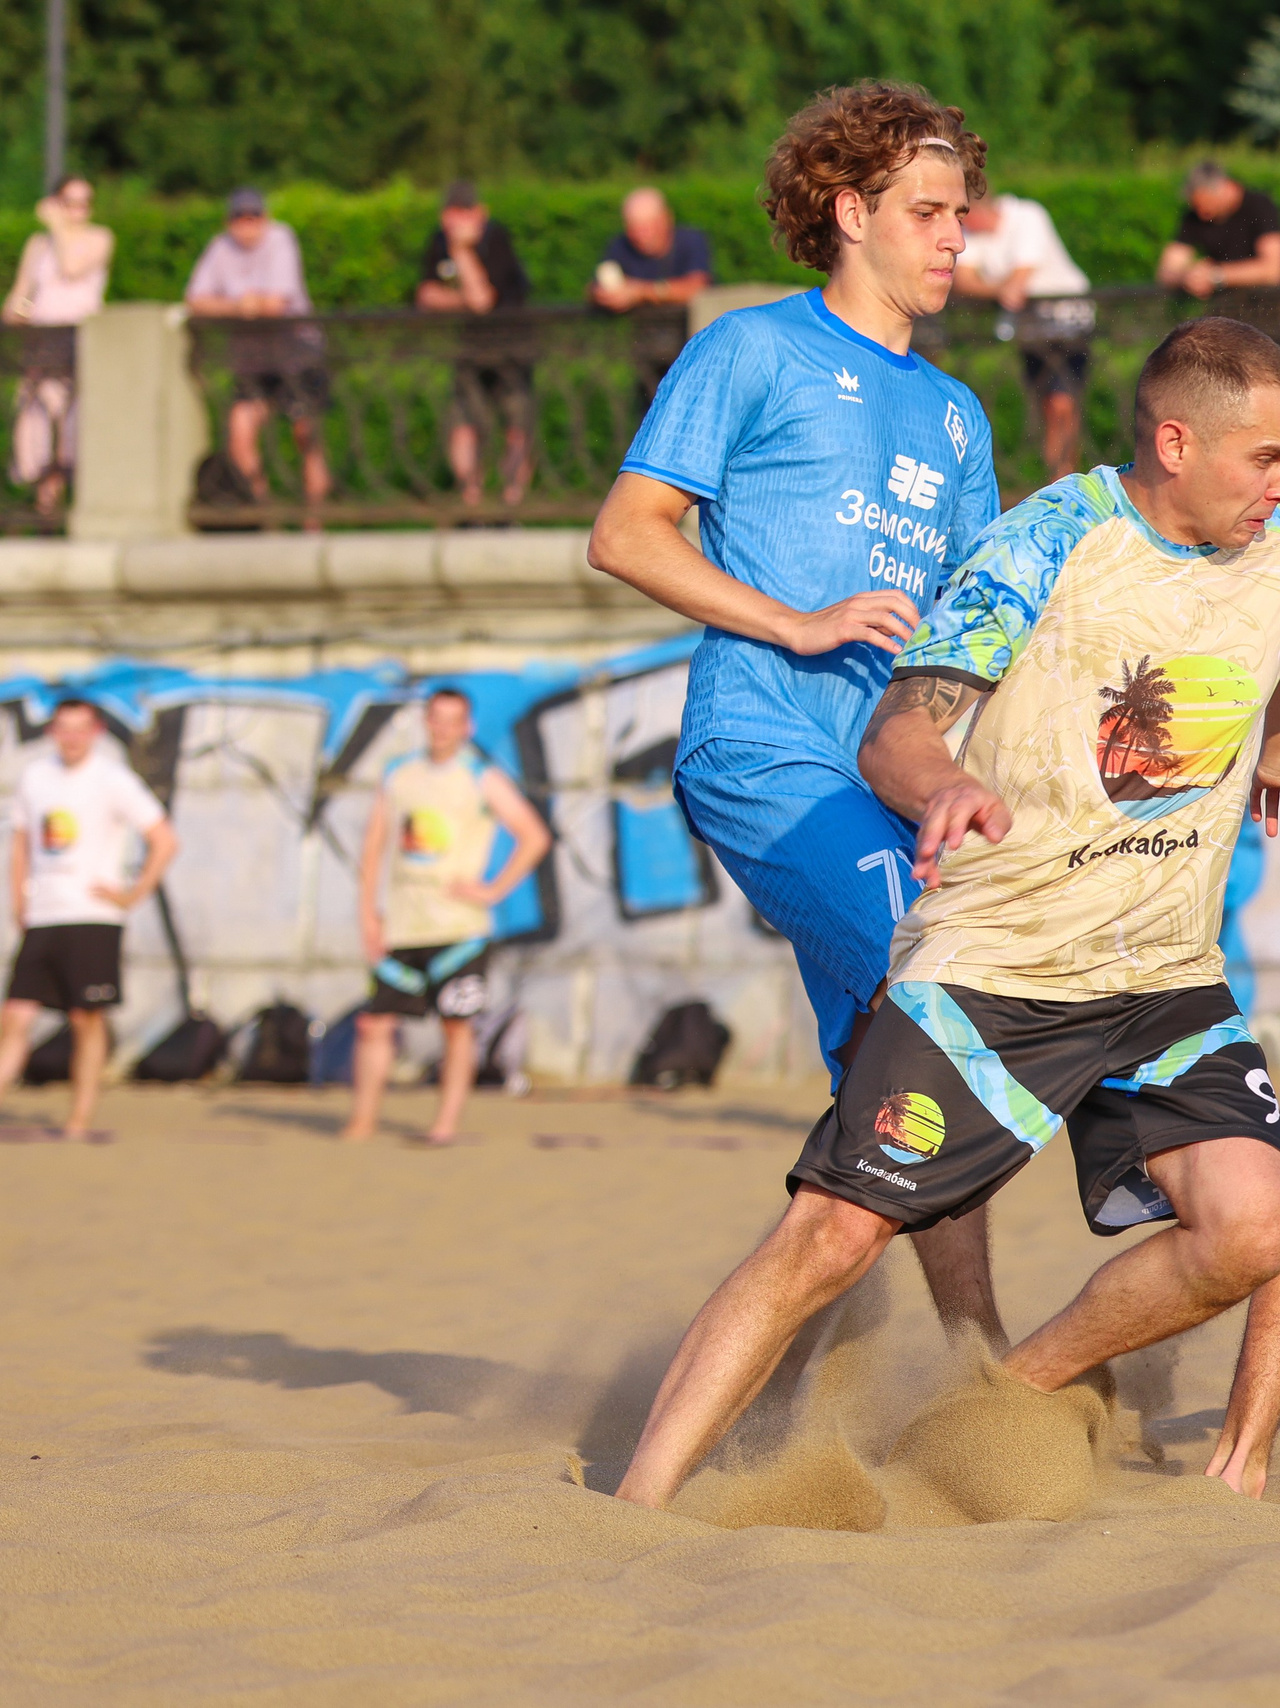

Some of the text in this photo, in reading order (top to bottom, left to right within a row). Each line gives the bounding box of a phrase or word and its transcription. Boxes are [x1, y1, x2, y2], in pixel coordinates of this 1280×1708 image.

[837, 394, 863, 404] PRIMERA
[869, 542, 927, 597] банк
[857, 847, 926, 923] 7
[856, 1158, 918, 1192] Копакабана
